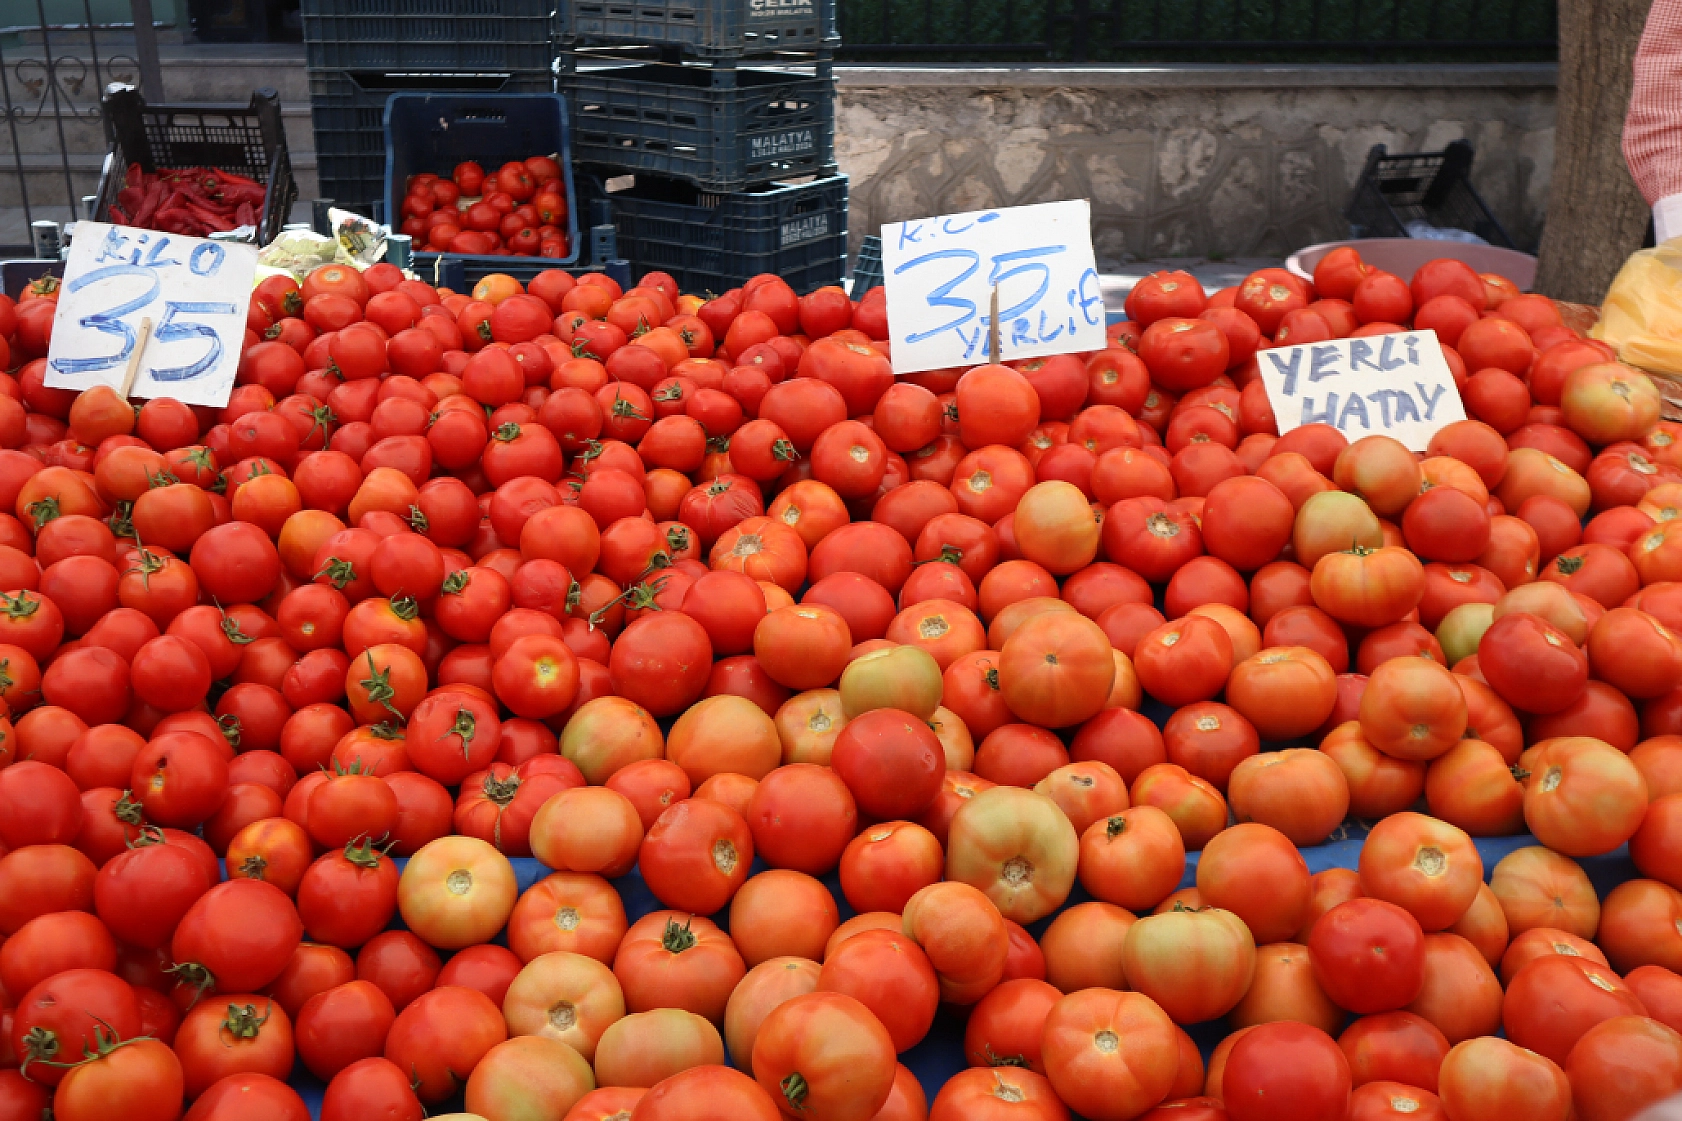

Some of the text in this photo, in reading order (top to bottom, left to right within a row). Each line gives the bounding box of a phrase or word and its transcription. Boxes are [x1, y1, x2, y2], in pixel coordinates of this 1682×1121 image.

[751, 130, 812, 148] MALATYA
[780, 213, 828, 236] MALATYA
[893, 245, 1066, 343] 35
[50, 264, 237, 382] 35
[1301, 381, 1447, 430] HATAY
